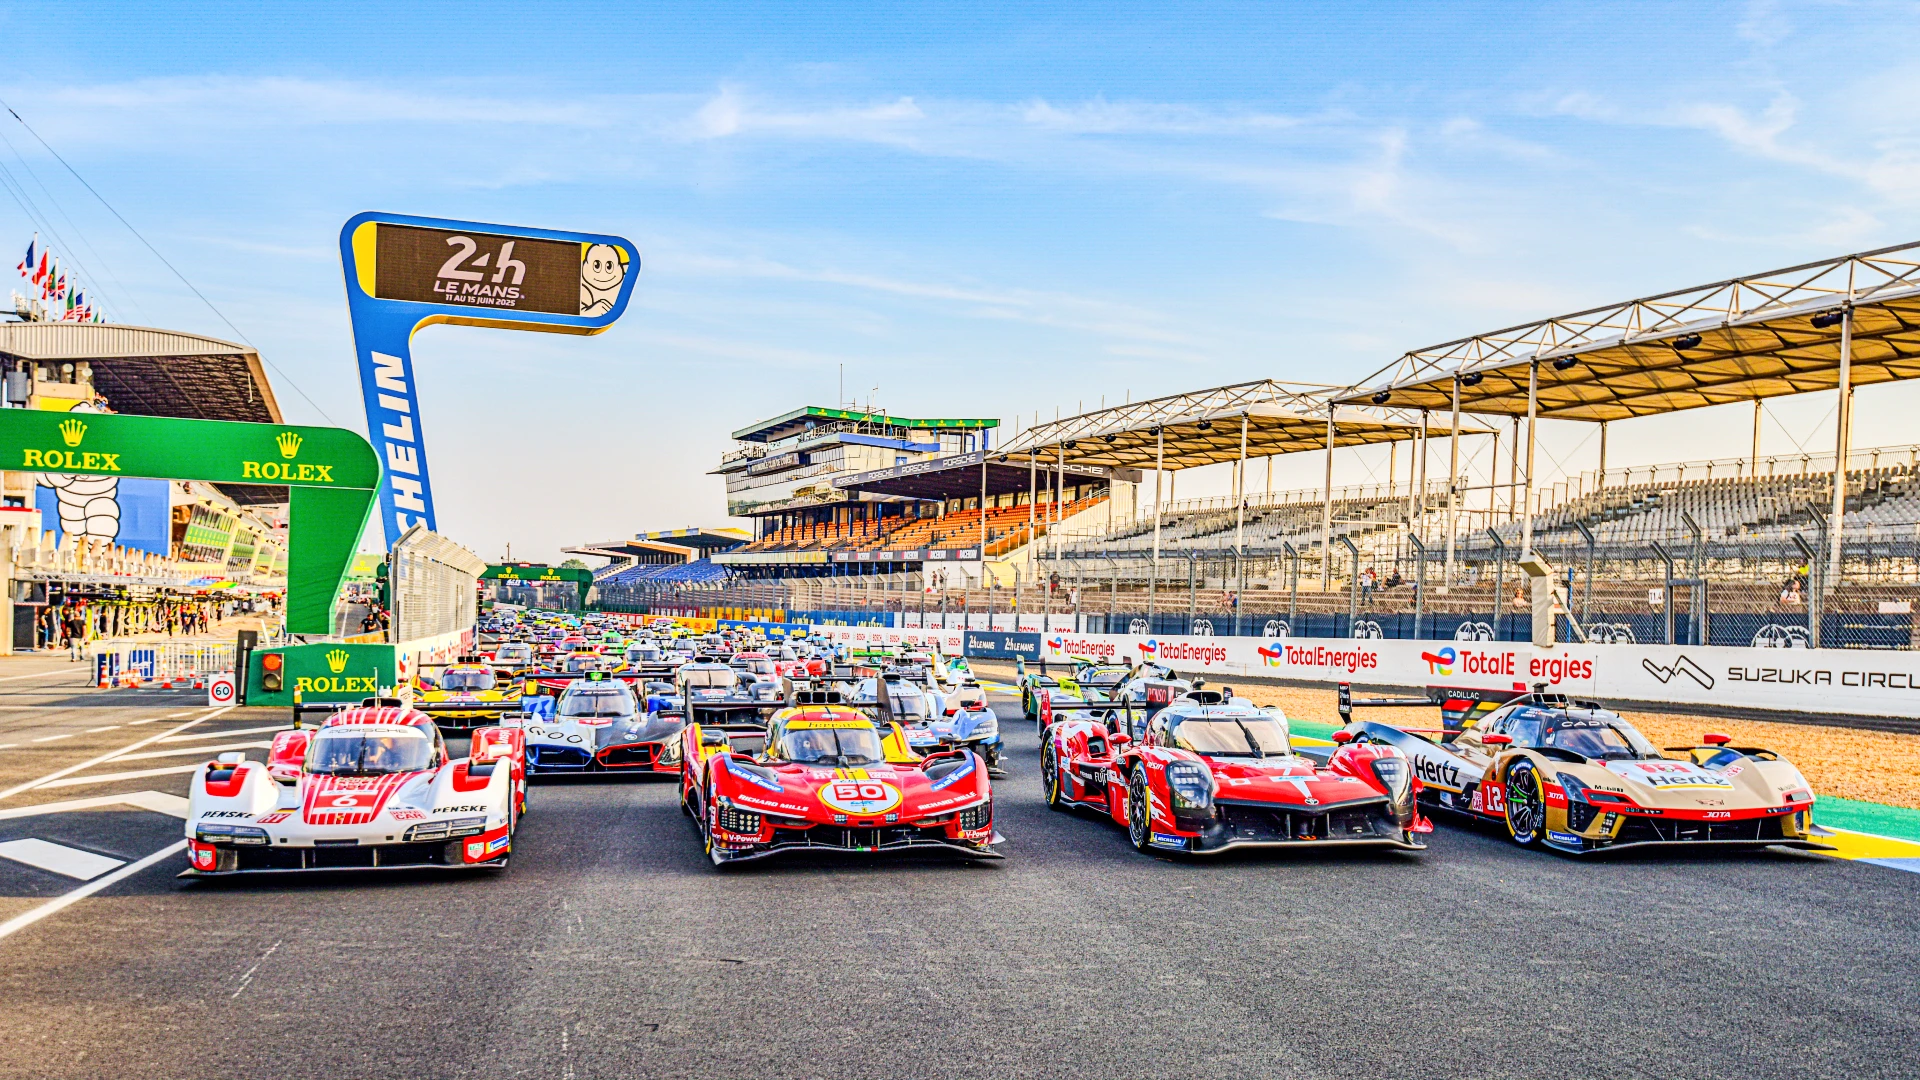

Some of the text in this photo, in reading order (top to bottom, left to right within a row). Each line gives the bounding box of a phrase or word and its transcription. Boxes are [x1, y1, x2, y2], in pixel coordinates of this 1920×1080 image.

[437, 236, 526, 285] 24h
[434, 280, 520, 299] LE MANS
[24, 449, 120, 471] ROLEX
[943, 454, 976, 467] PORSCHE
[242, 462, 334, 482] ROLEX
[868, 469, 894, 479] PORSCHE
[902, 463, 930, 474] PORSCHE
[836, 475, 858, 485] PORSCHE
[1020, 643, 1035, 652] MANS
[1064, 639, 1114, 658] TotalEnergies
[1158, 642, 1226, 665] TotalEnergies
[1285, 646, 1377, 673] TotalEnergies
[1728, 667, 1832, 685] SUZUKA
[216, 686, 229, 695] 60
[296, 677, 376, 693] ROLEX
[1148, 688, 1166, 703] DENSO
[1448, 690, 1480, 700] CADILLAC
[1415, 754, 1460, 788] Hertz
[758, 781, 781, 791] GROUP
[1646, 775, 1729, 786] Hertz
[836, 785, 883, 798] 50
[1486, 785, 1504, 812] 12
[1547, 792, 1564, 800] JOTA
[332, 794, 358, 806] 6
[738, 794, 809, 812] RICHARD MILLE
[918, 791, 977, 810] RICHARD MILLE
[433, 806, 487, 814] PENSKE
